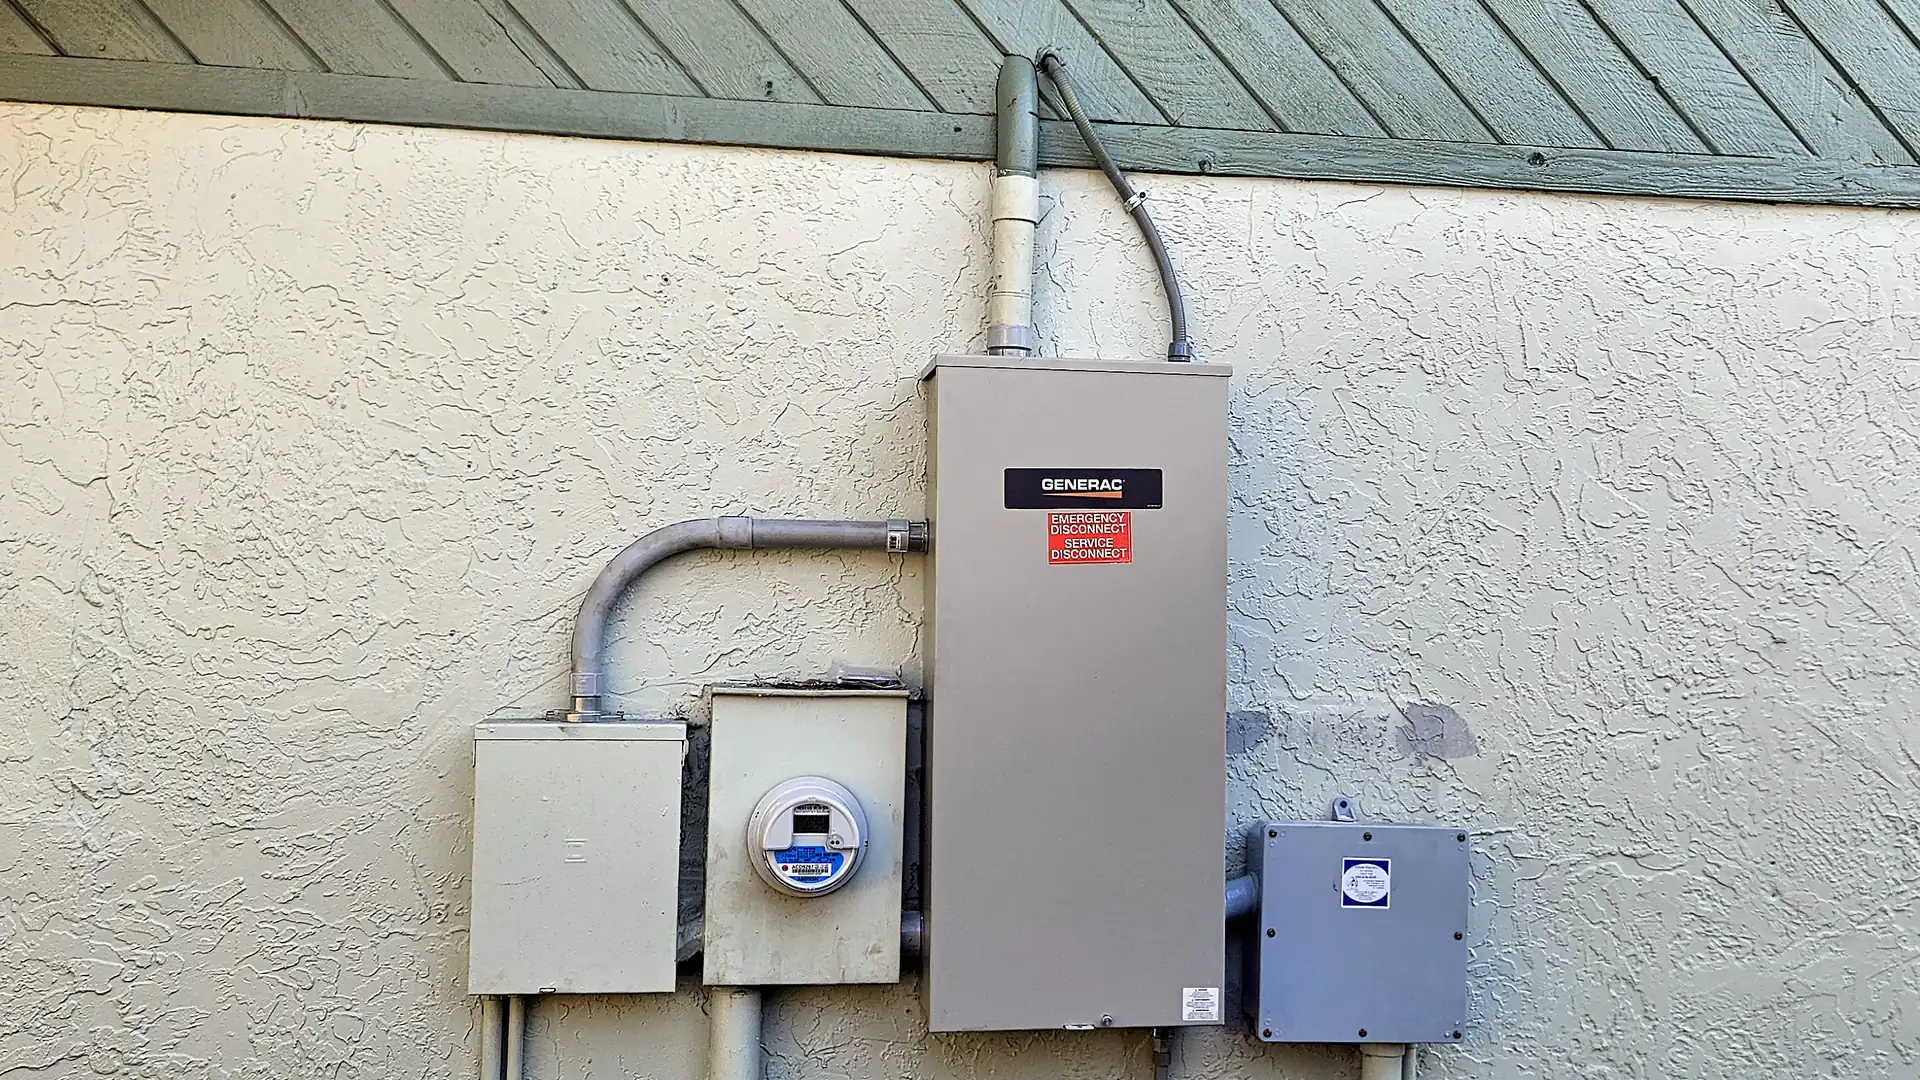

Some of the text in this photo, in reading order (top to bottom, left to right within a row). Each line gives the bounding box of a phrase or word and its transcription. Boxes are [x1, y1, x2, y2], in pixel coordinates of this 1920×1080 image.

[1041, 478, 1123, 491] GENERAC
[1051, 513, 1125, 524] EMERGENCY
[1050, 524, 1127, 535] DISCONNECT
[1064, 537, 1114, 549] SERVICE
[1051, 548, 1128, 560] DISCONNECT
